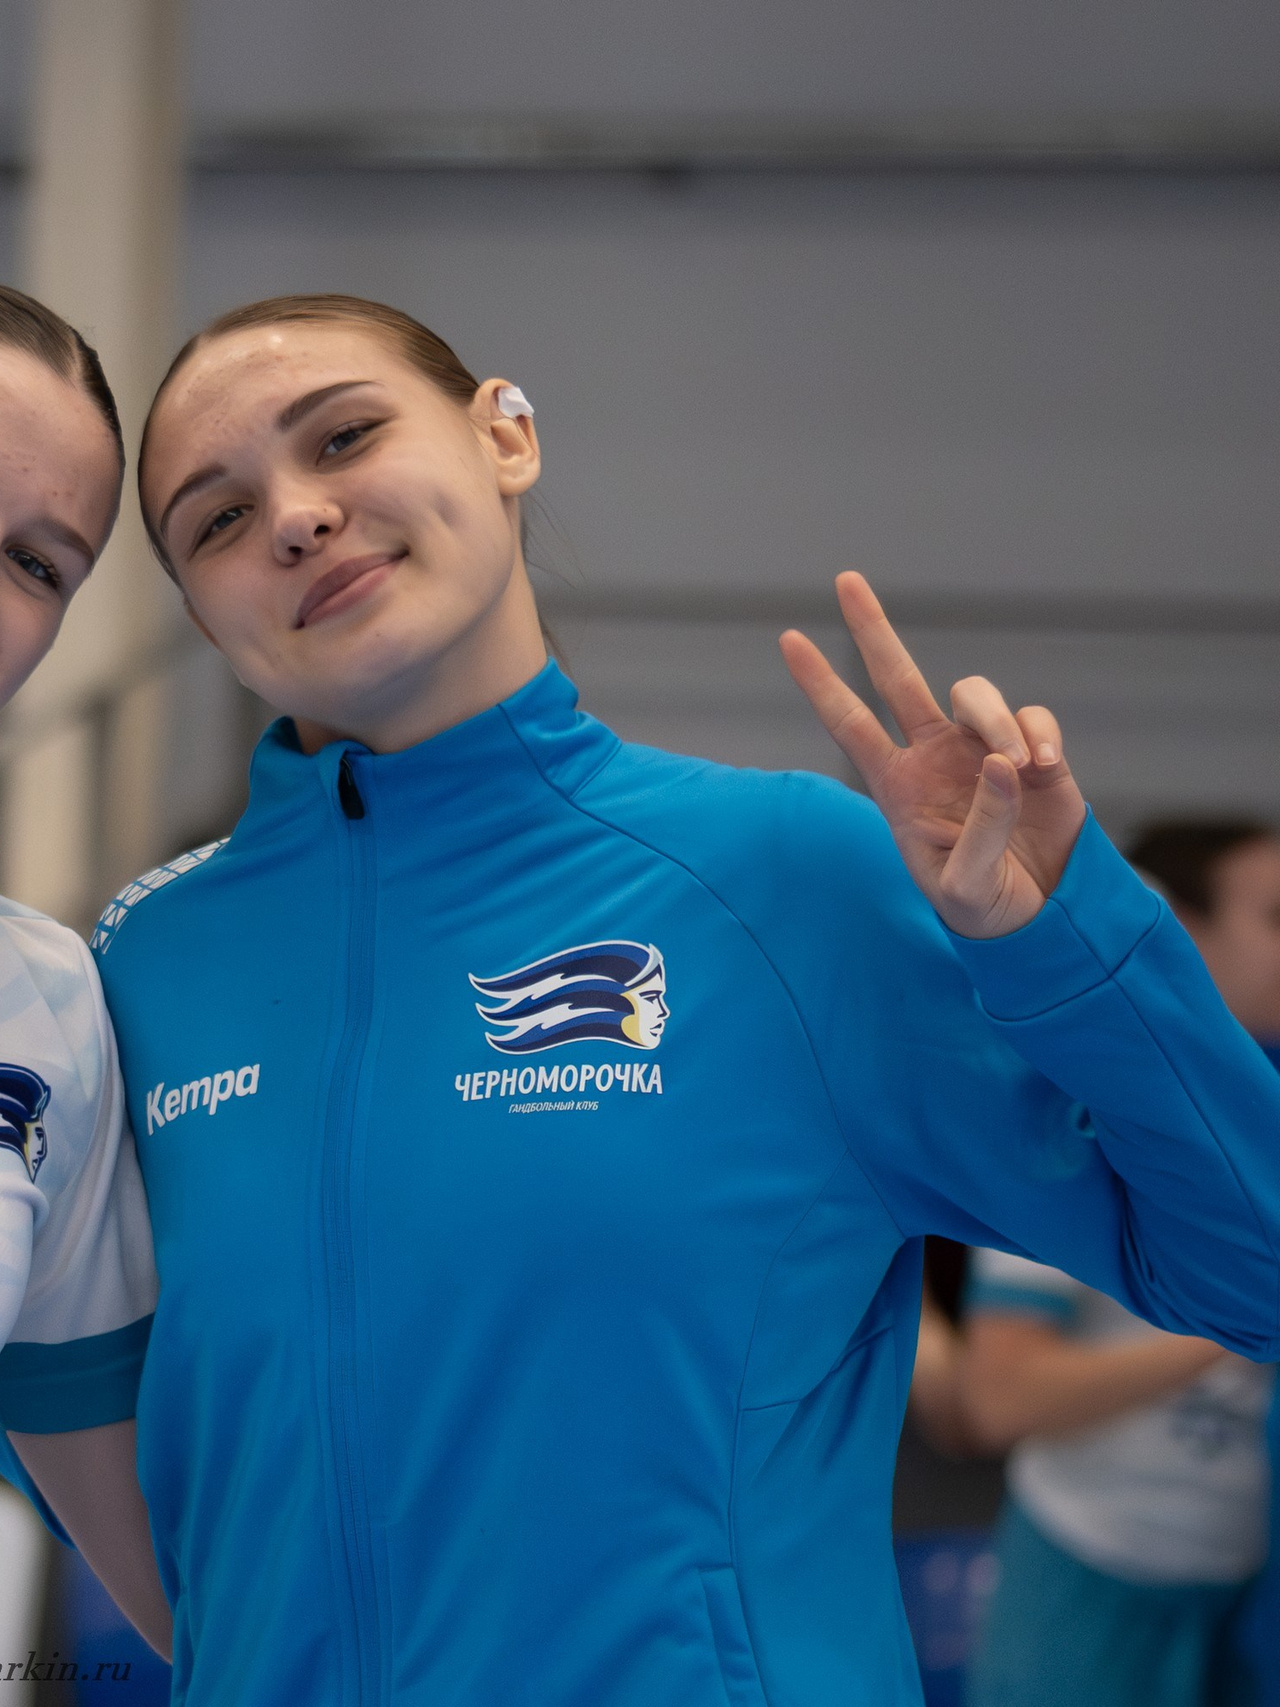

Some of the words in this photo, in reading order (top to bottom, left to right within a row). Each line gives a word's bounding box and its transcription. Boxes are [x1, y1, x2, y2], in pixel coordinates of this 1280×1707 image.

[146, 1063, 260, 1136] Kempa
[454, 1063, 663, 1101] ЧЕРНОМОРОЧКА
[508, 1100, 575, 1114] ГАНДБОЛЬНЫЙ
[575, 1100, 599, 1111] КЛУБ
